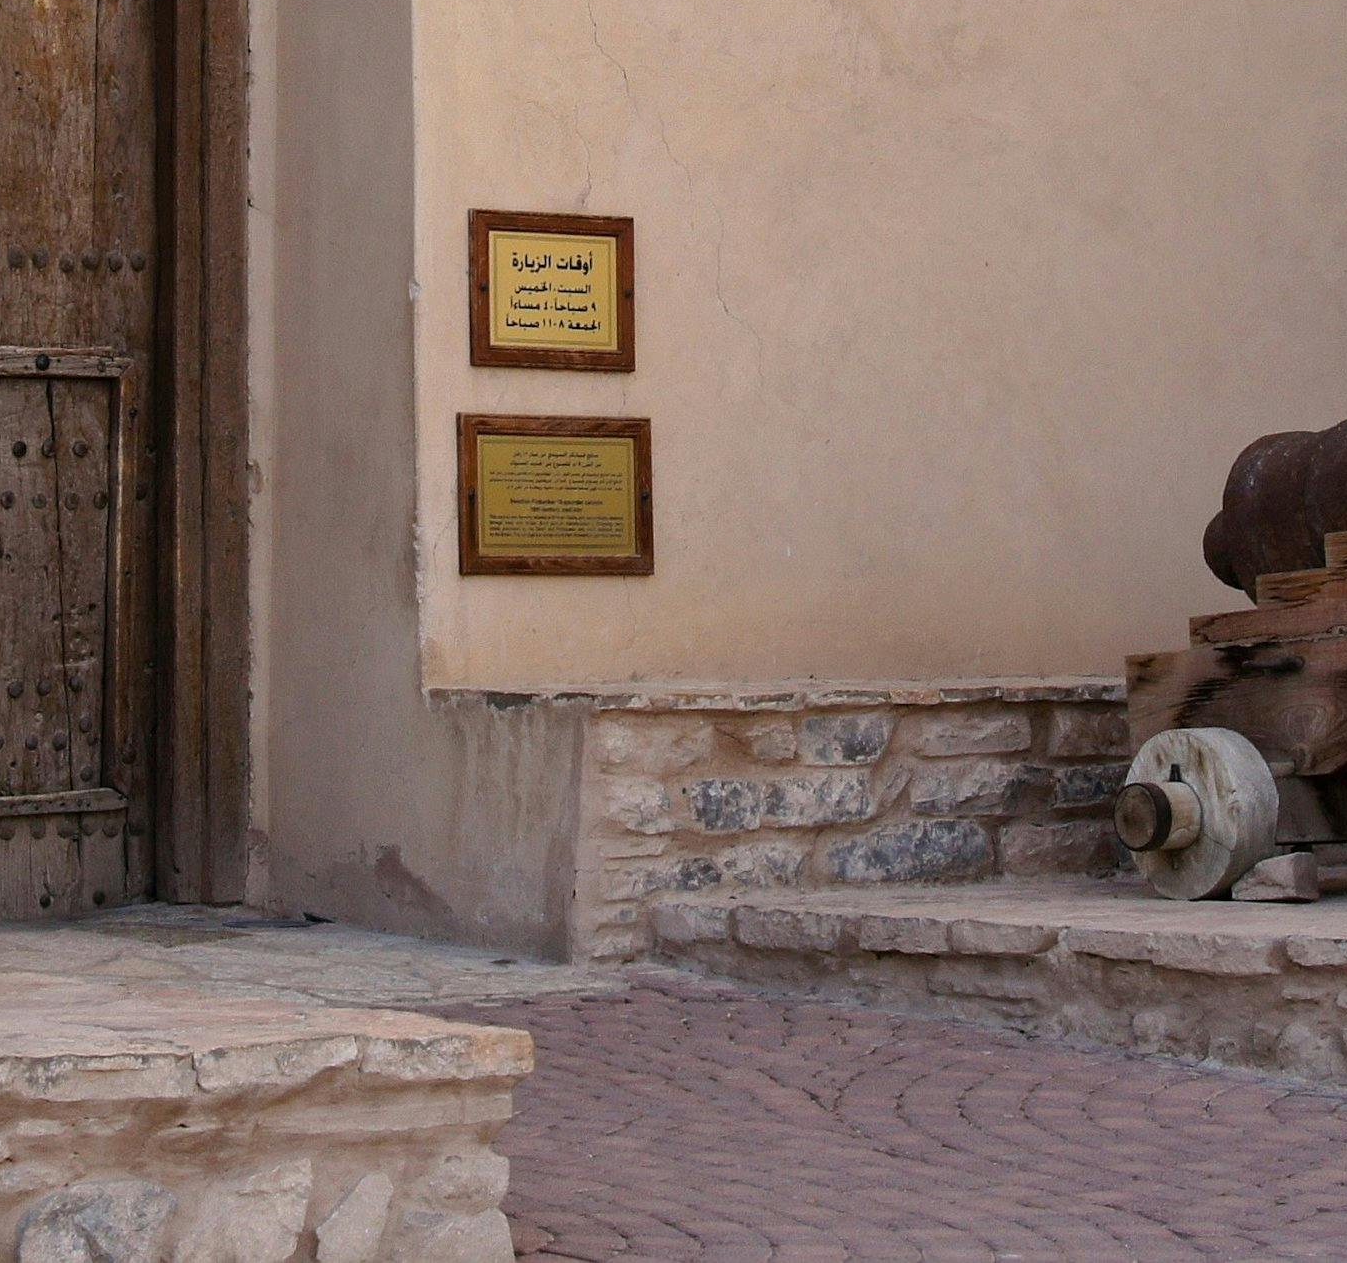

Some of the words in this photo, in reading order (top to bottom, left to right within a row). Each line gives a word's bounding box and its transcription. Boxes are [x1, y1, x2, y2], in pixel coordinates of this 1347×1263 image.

[512, 252, 552, 273] الزيارة
[556, 251, 593, 275] أوقات
[568, 319, 601, 333] الجمعة
